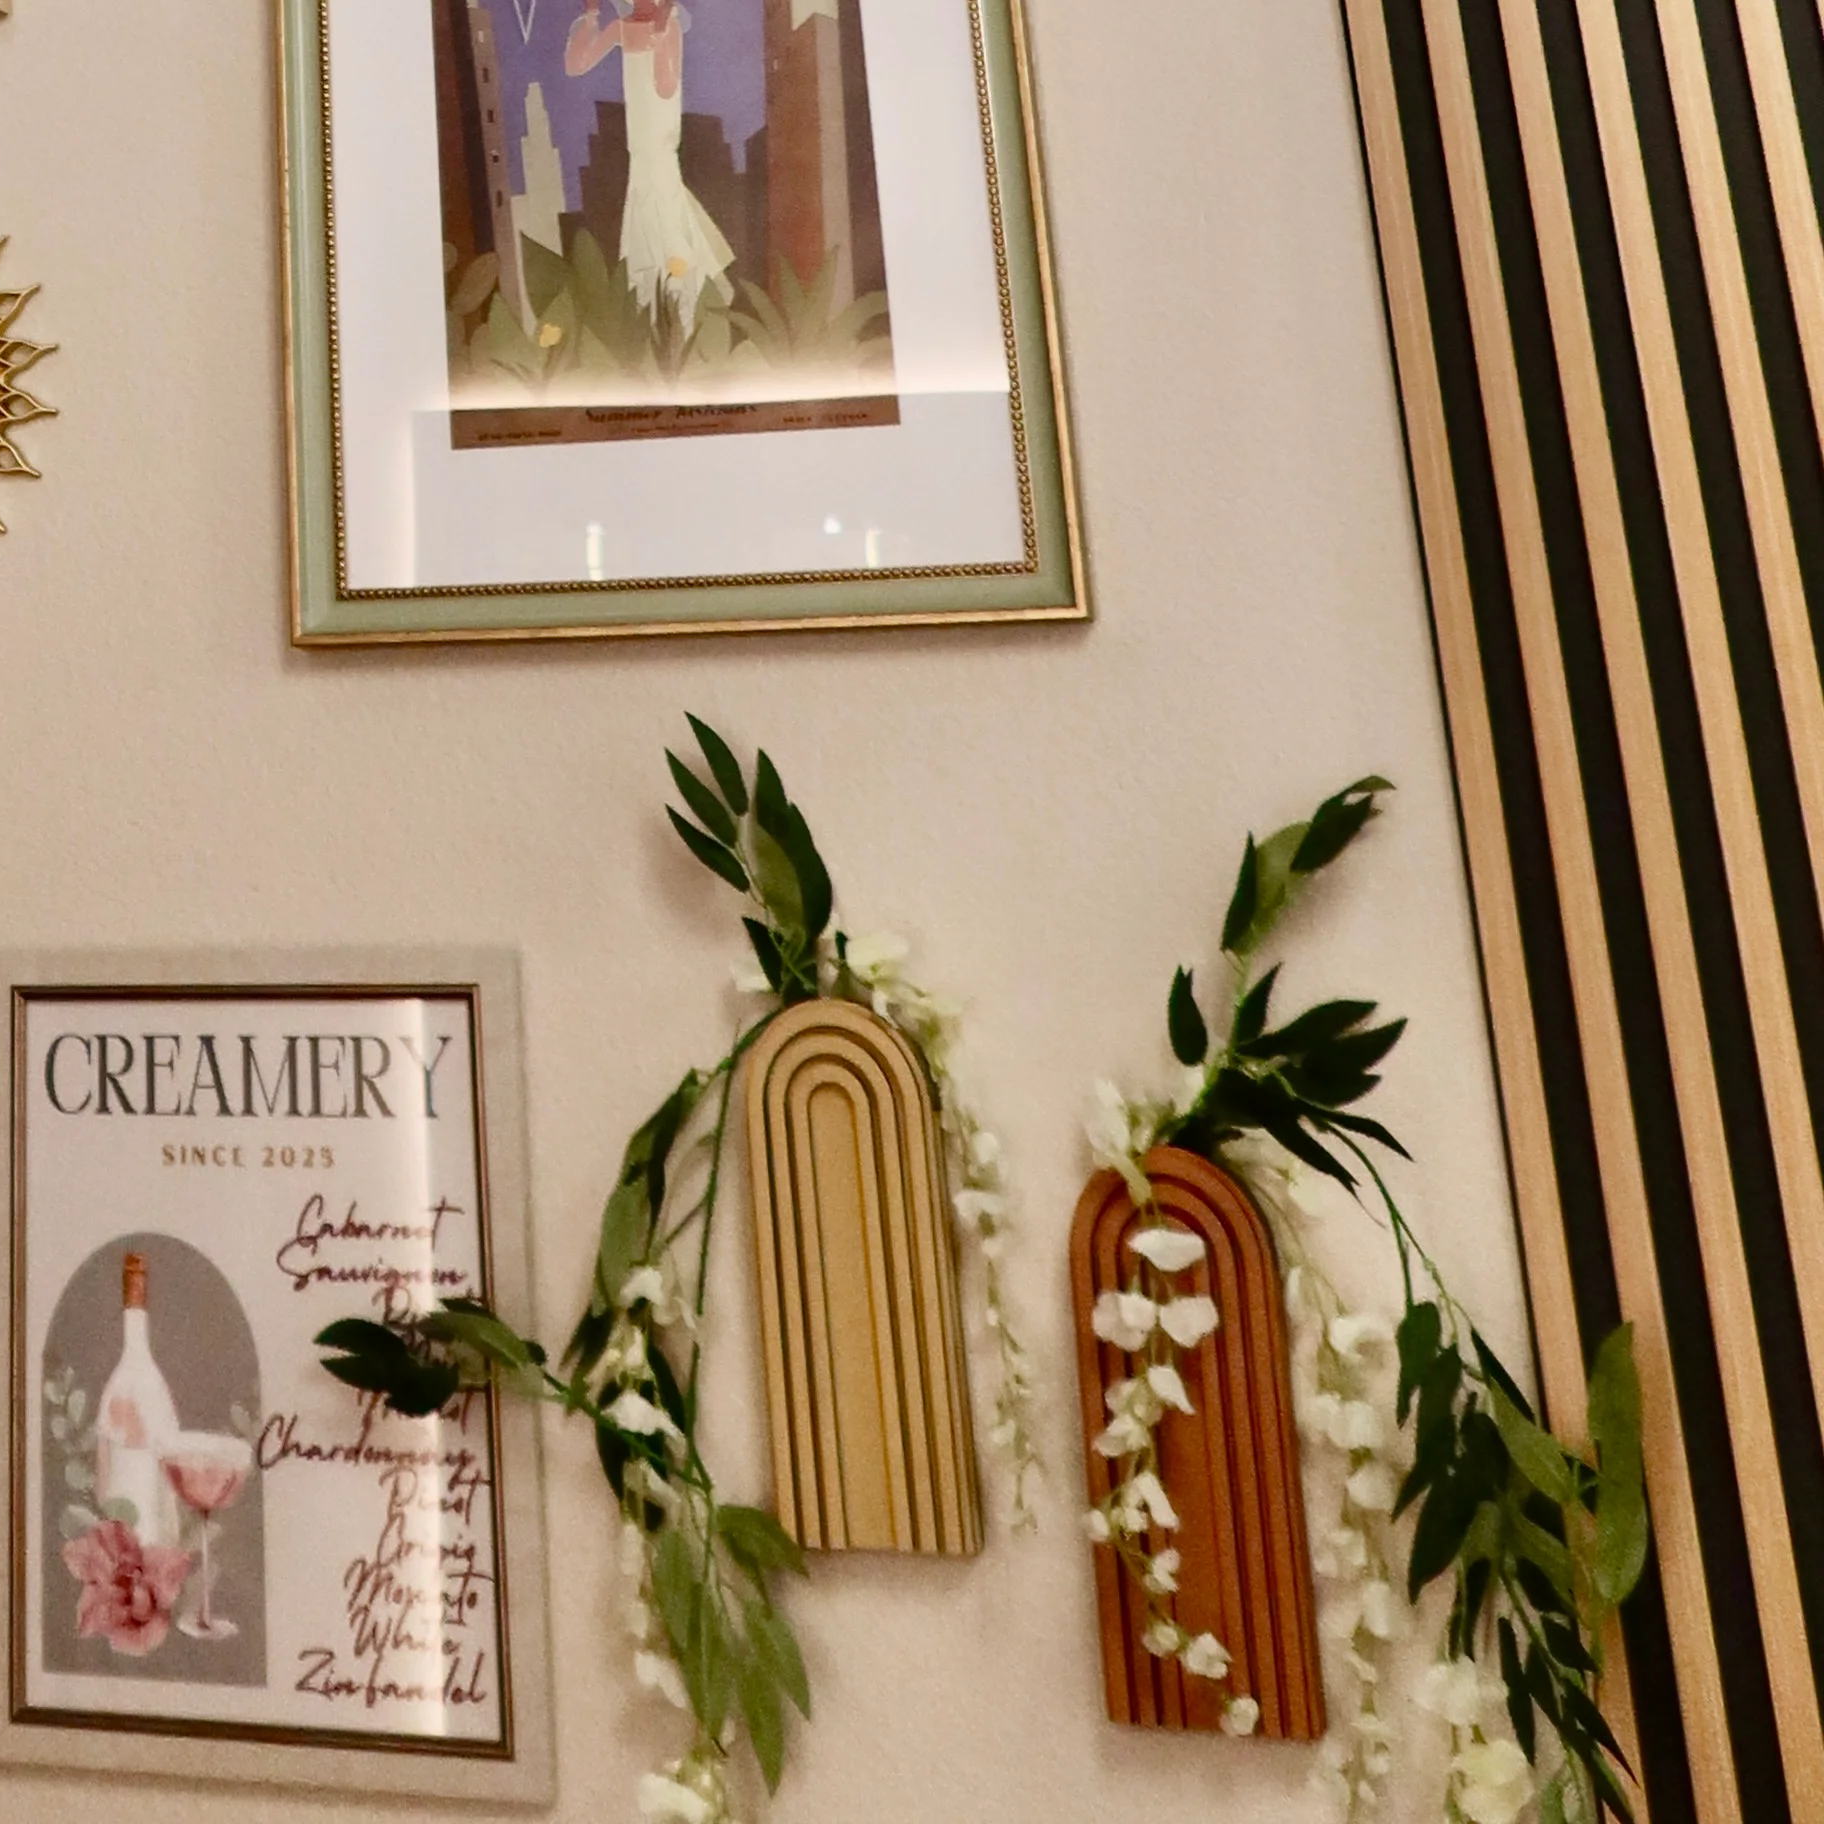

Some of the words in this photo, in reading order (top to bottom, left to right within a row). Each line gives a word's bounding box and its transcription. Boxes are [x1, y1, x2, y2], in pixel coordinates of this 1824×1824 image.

[44, 1032, 453, 1119] CREAMERY
[161, 1144, 248, 1167] SINCE
[261, 1145, 336, 1168] 2025
